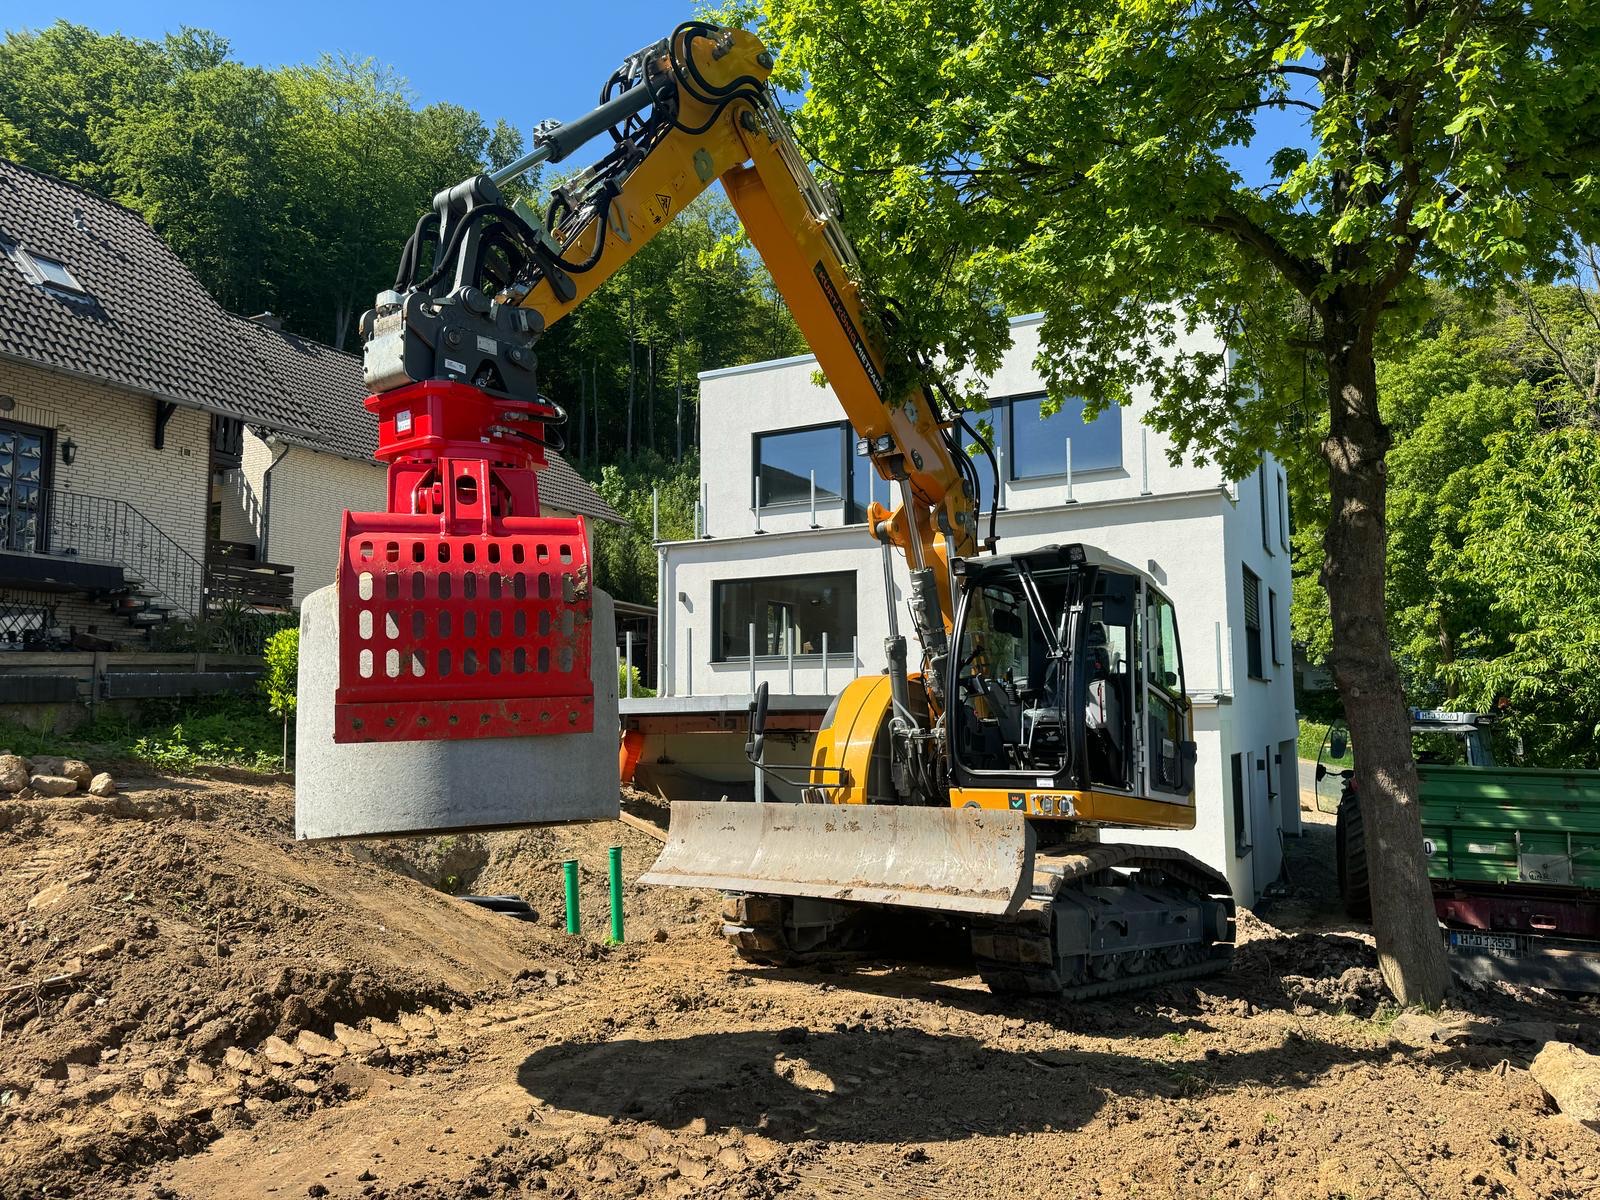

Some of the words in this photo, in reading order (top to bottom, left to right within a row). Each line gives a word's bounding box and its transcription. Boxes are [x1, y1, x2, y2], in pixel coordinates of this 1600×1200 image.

[818, 271, 839, 305] KURT
[855, 342, 884, 396] MIETPARK
[1425, 841, 1432, 854] 0
